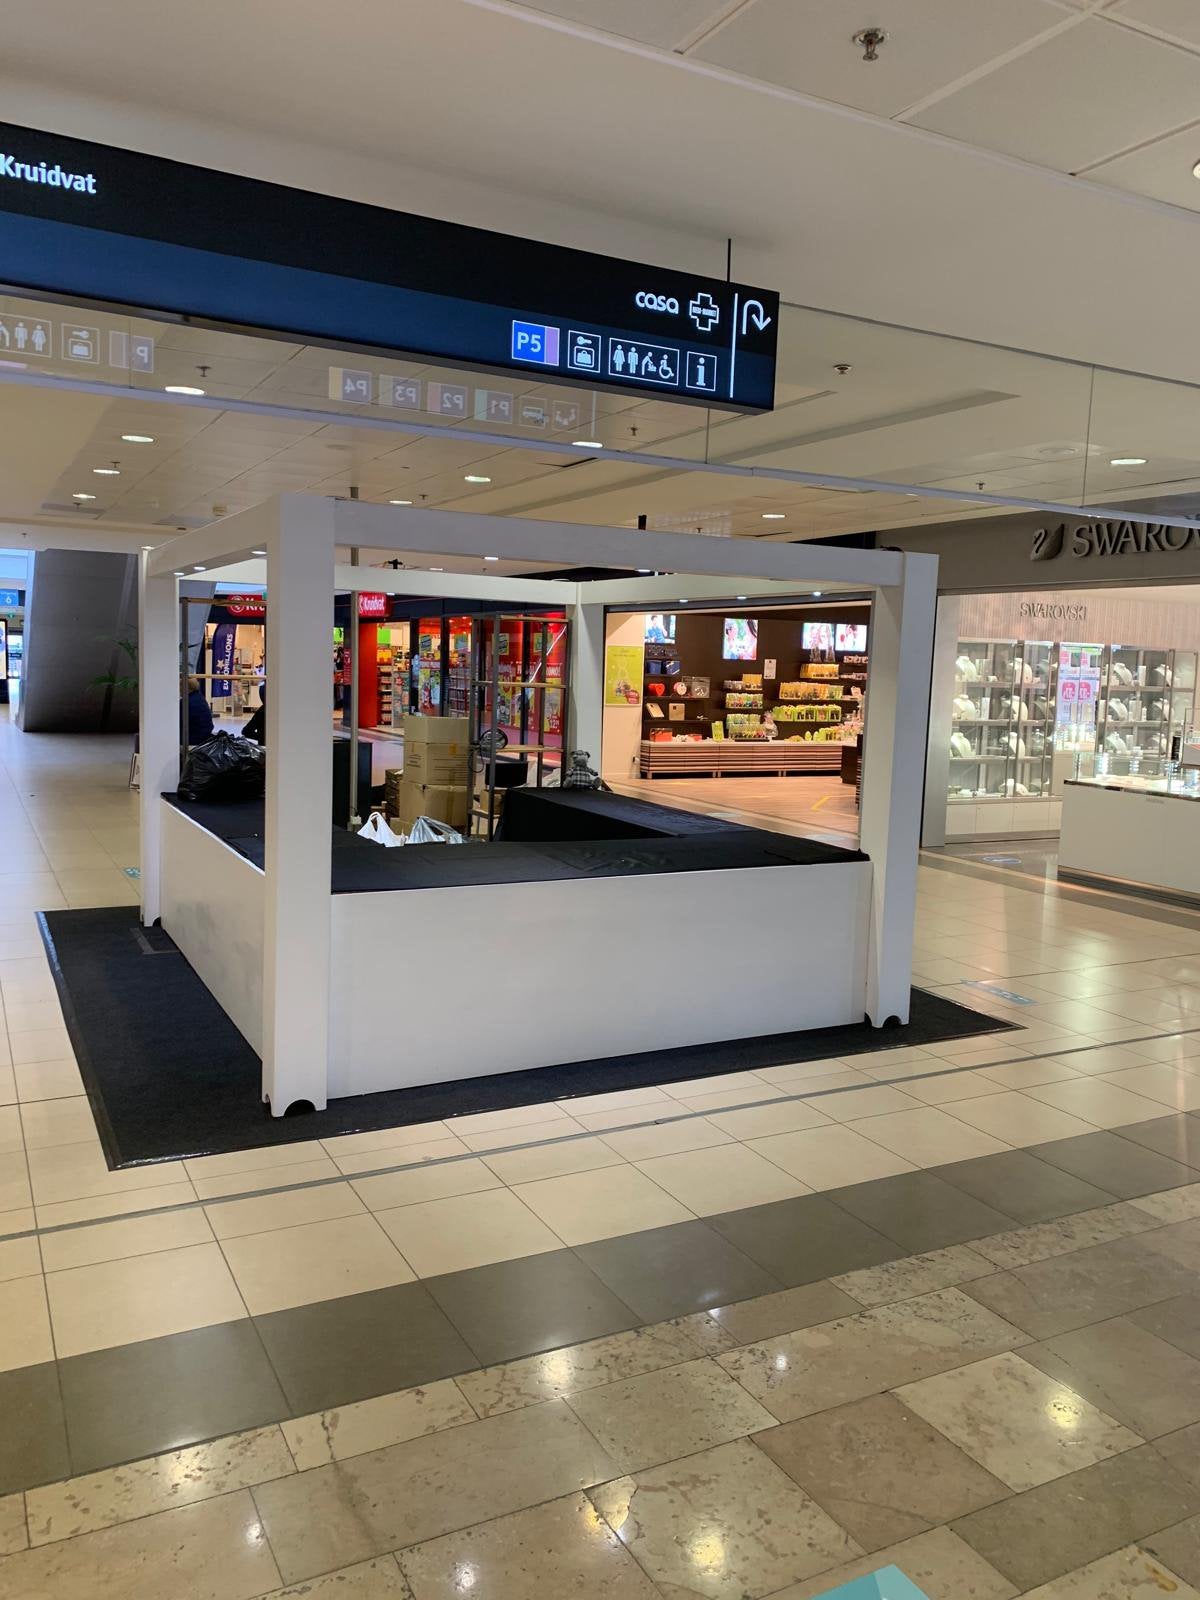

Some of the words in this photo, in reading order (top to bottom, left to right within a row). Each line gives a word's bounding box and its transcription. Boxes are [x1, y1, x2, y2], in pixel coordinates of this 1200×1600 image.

[0, 153, 97, 194] Kruidvat
[635, 291, 679, 314] casa
[517, 331, 541, 353] P5
[1073, 520, 1200, 558] SWARO
[1020, 602, 1087, 621] SWAROVSKI
